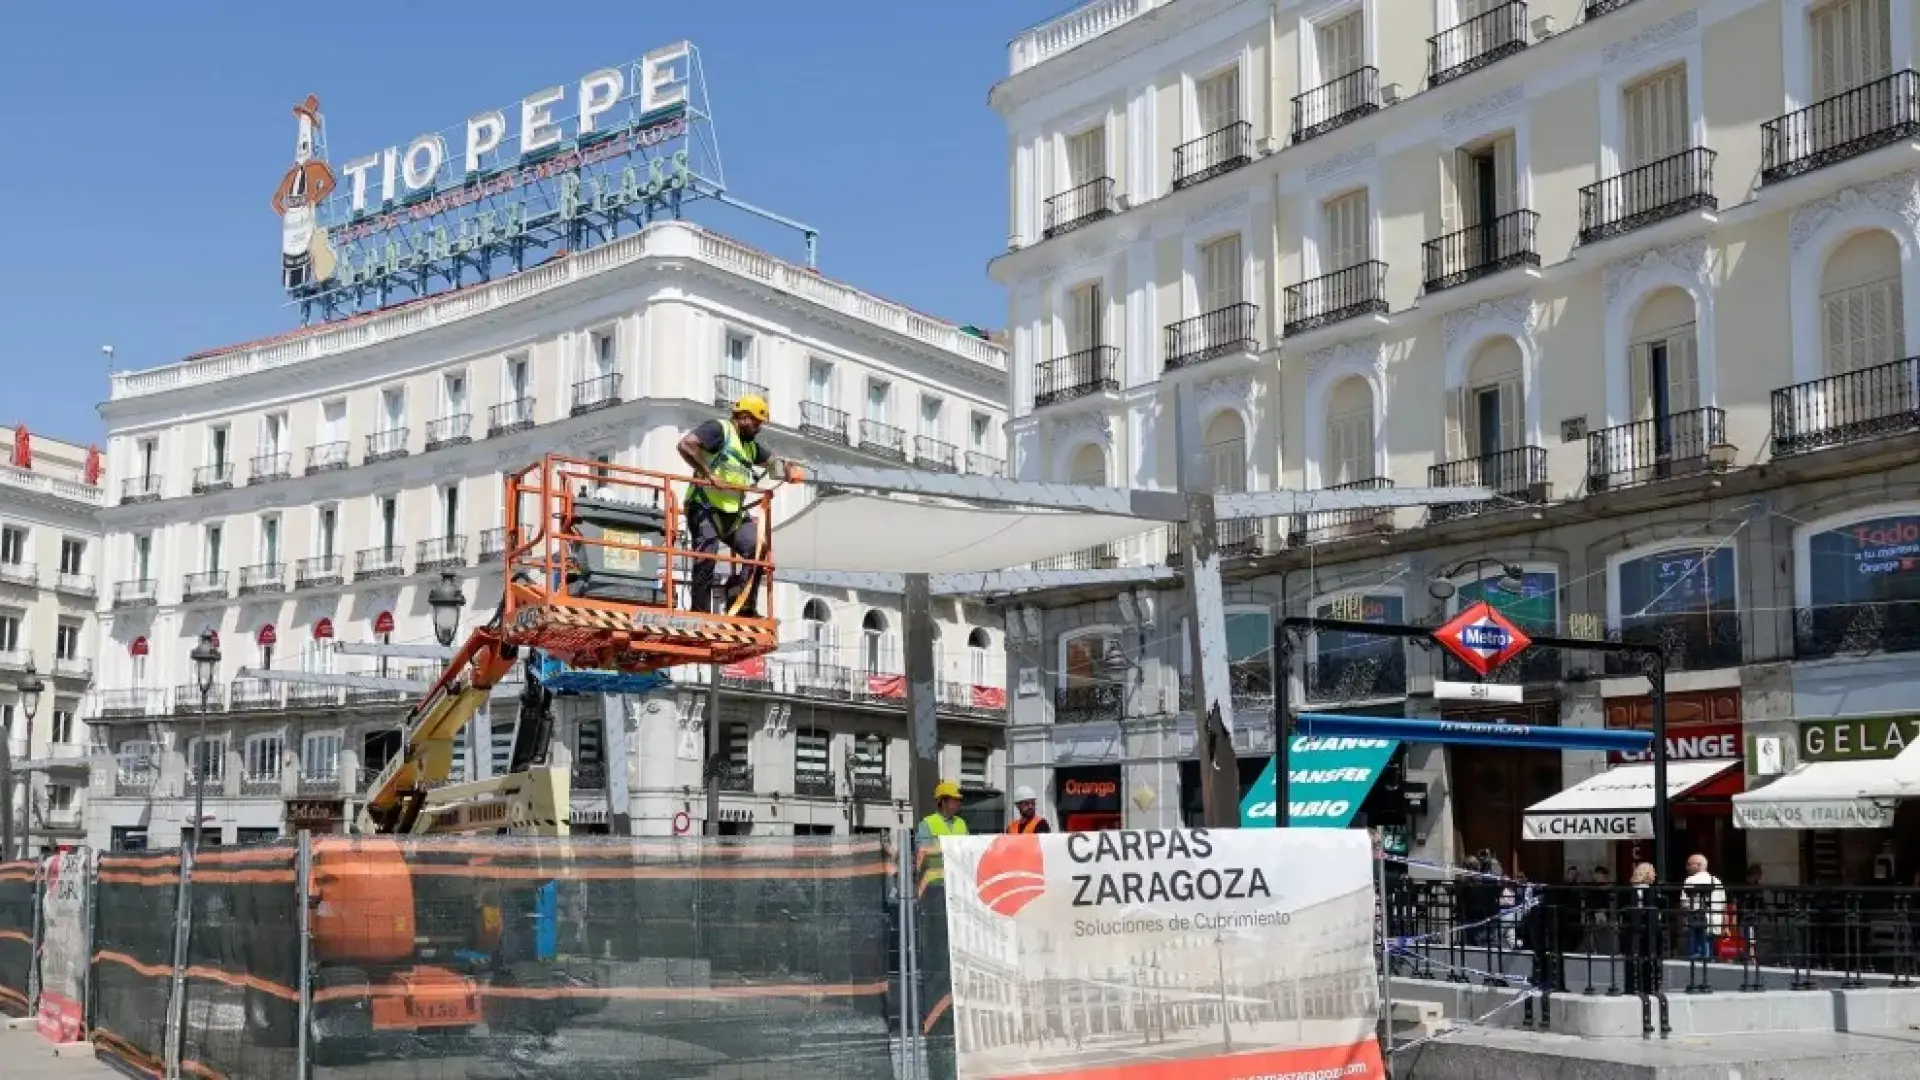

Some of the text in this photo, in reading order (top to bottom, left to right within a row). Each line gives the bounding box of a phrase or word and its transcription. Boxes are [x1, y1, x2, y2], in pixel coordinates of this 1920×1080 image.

[343, 132, 444, 211] TIO
[464, 41, 690, 172] PEPE
[1859, 560, 1899, 573] Orange
[1465, 627, 1506, 646] Metro
[1621, 734, 1735, 761] ANGE
[1065, 779, 1116, 796] Orange
[1549, 817, 1636, 834] CHANGE
[1068, 829, 1213, 864] CARPAS
[1071, 868, 1271, 907] ZARAGOZA
[1075, 911, 1291, 937] Soluciones de Cubrimiento
